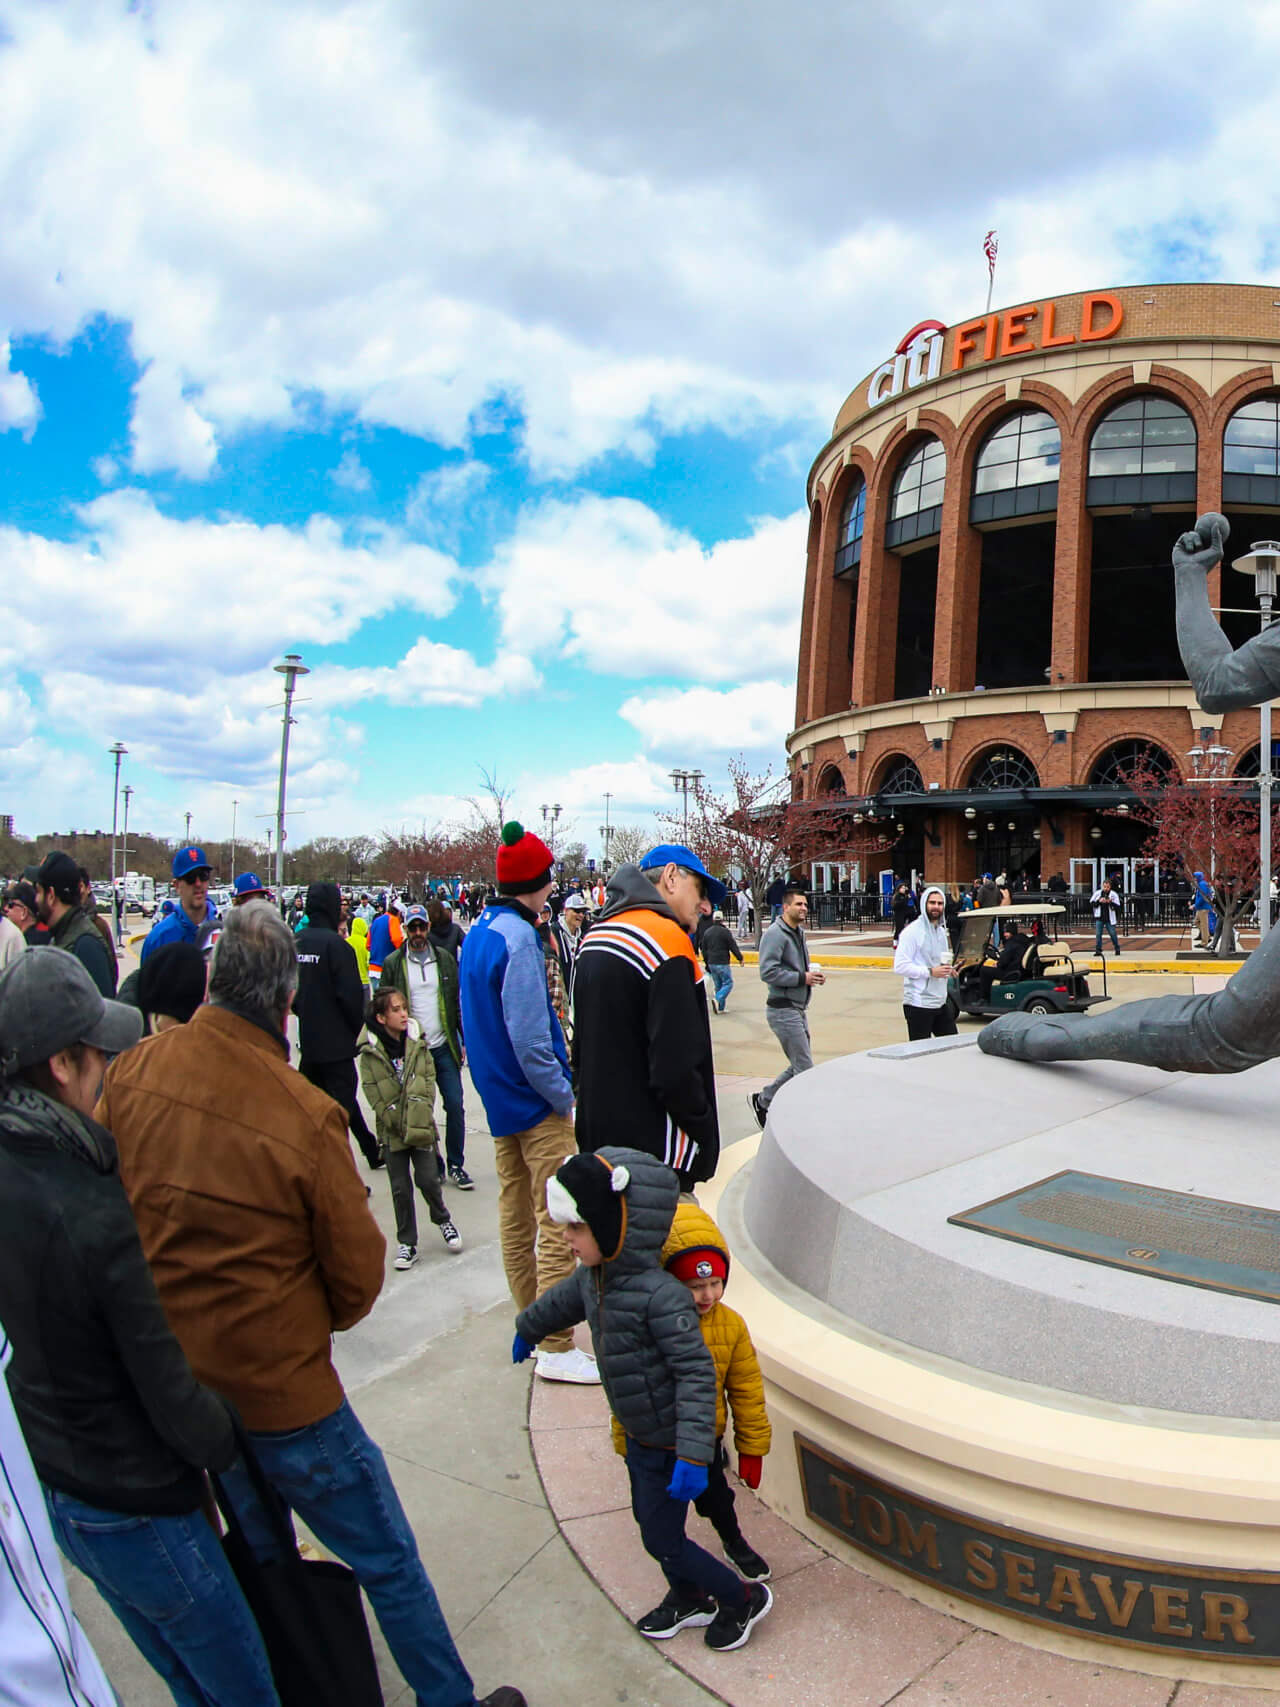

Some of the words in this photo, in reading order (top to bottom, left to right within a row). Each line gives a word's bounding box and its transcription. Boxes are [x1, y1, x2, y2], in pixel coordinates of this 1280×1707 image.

[868, 328, 947, 408] citi
[952, 294, 1124, 371] FIELD
[828, 1474, 944, 1572] TOM
[963, 1540, 1256, 1645] SEAVER
